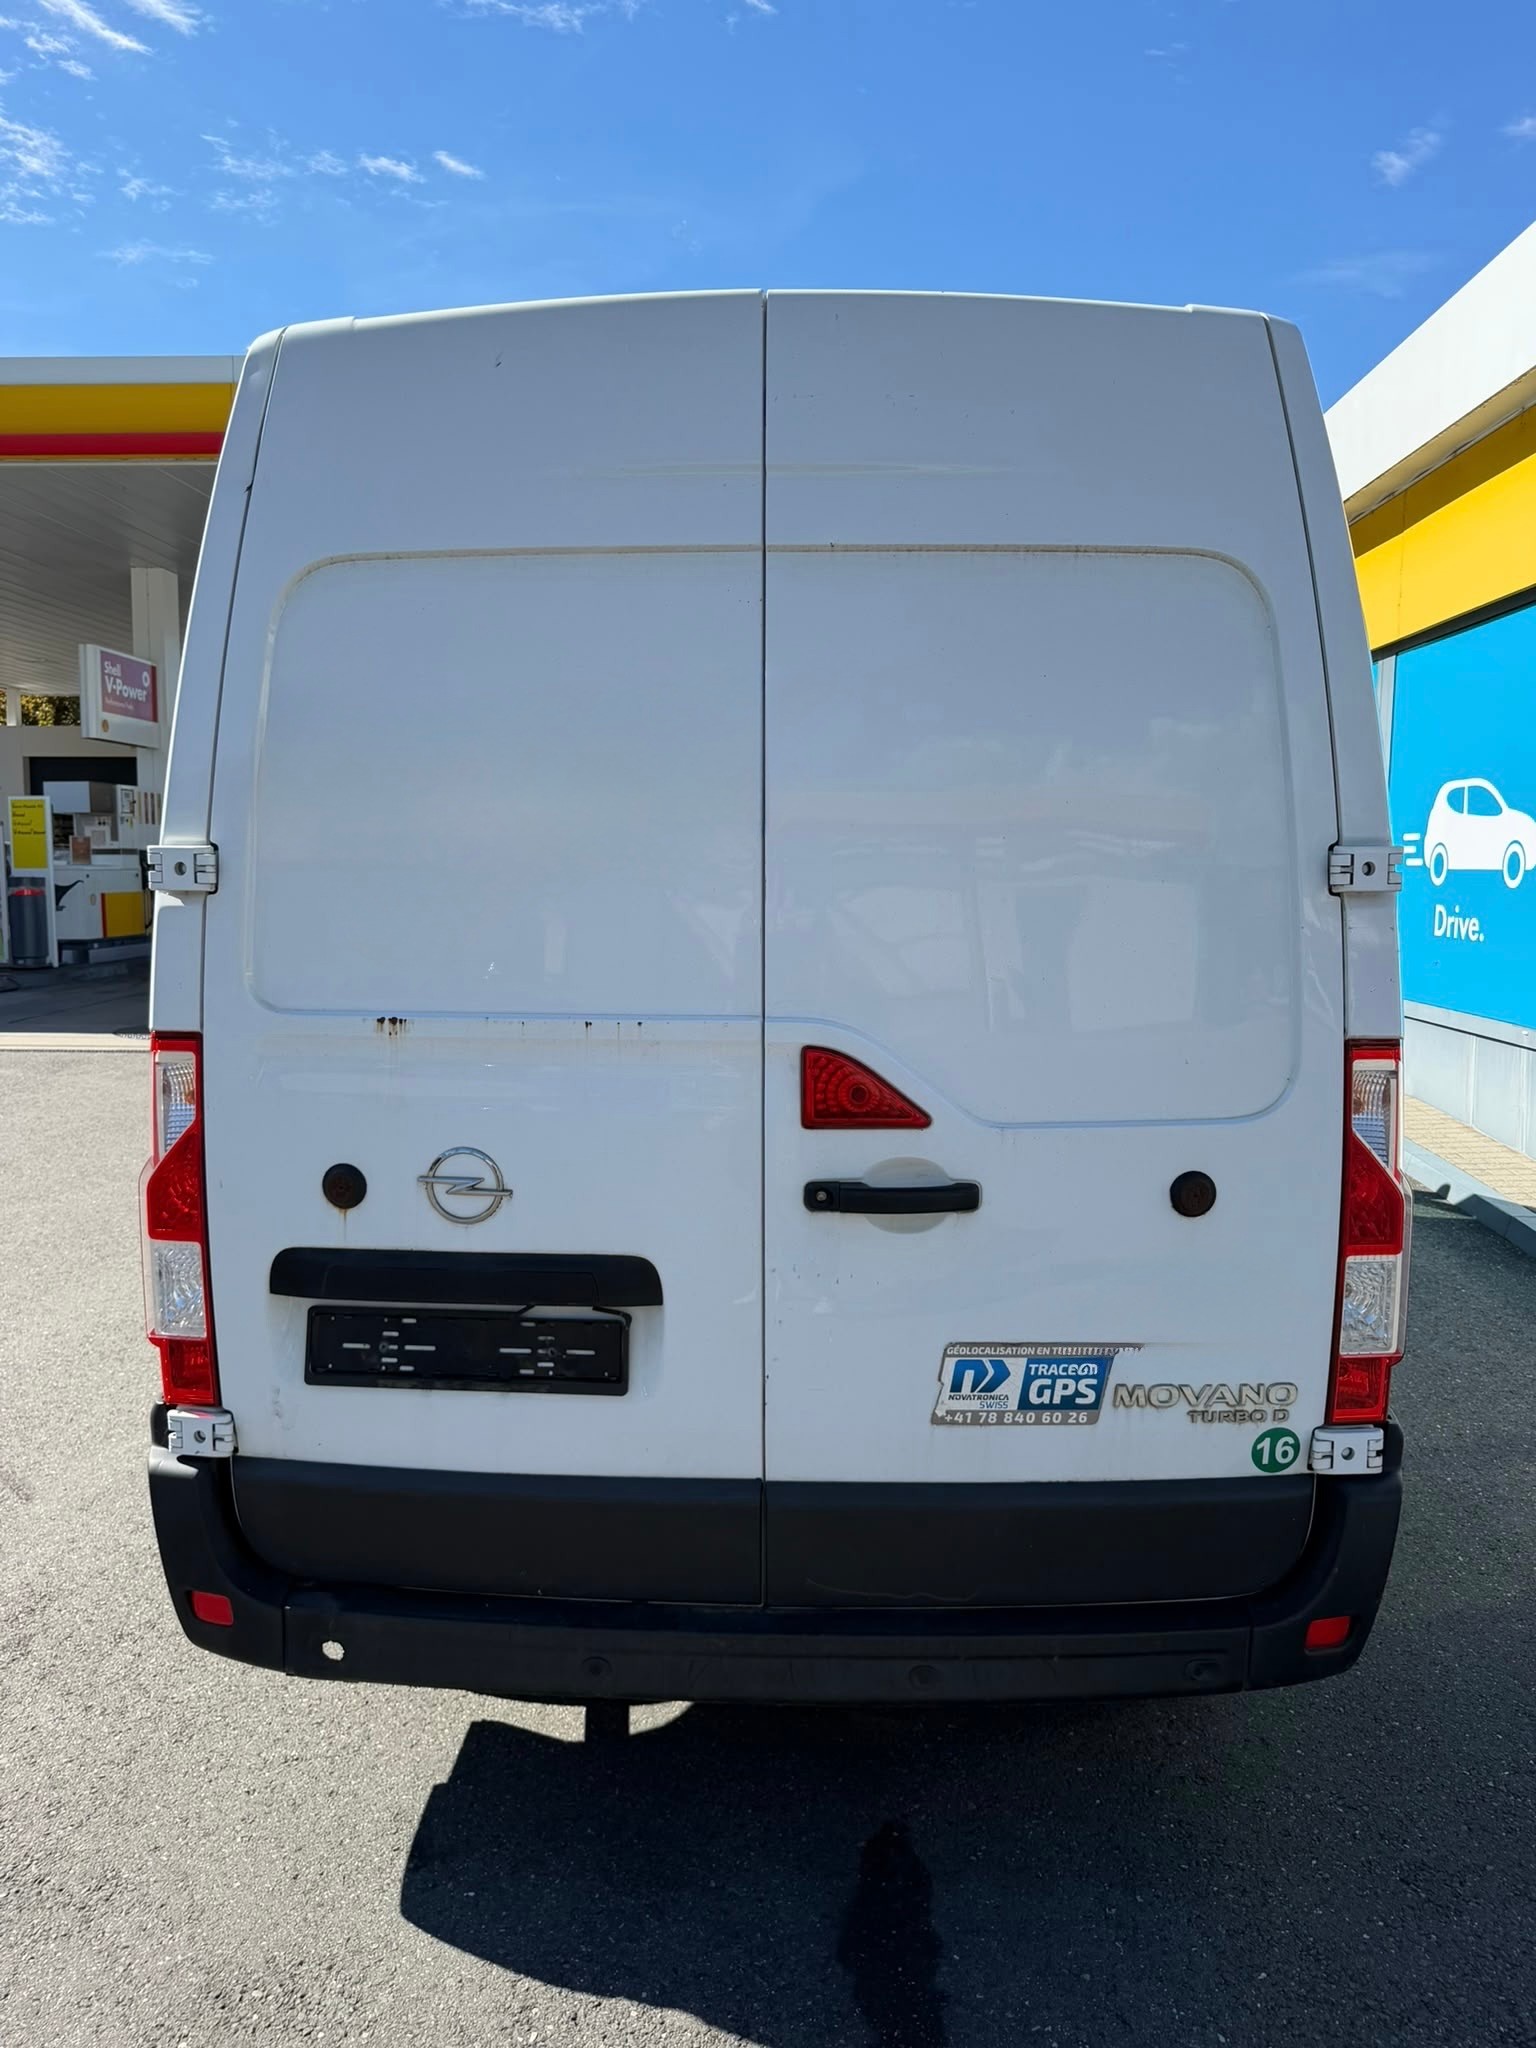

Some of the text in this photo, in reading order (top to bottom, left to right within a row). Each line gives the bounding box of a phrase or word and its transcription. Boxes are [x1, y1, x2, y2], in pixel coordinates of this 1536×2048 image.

[104, 660, 122, 677] Shell
[104, 675, 147, 703] V-Power
[1433, 904, 1485, 942] Drive.
[946, 1345, 1037, 1356] GÉOLOCALISATION
[1037, 1346, 1052, 1356] EN
[948, 1393, 1009, 1401] NOVATRONICA
[1028, 1378, 1099, 1405] GPS
[1112, 1381, 1298, 1409] MOVANO
[979, 1400, 1009, 1409] SWISS
[944, 1411, 1088, 1424] +41 78 840 60 26
[1187, 1408, 1290, 1424] TURBO D
[1256, 1436, 1295, 1465] 16
